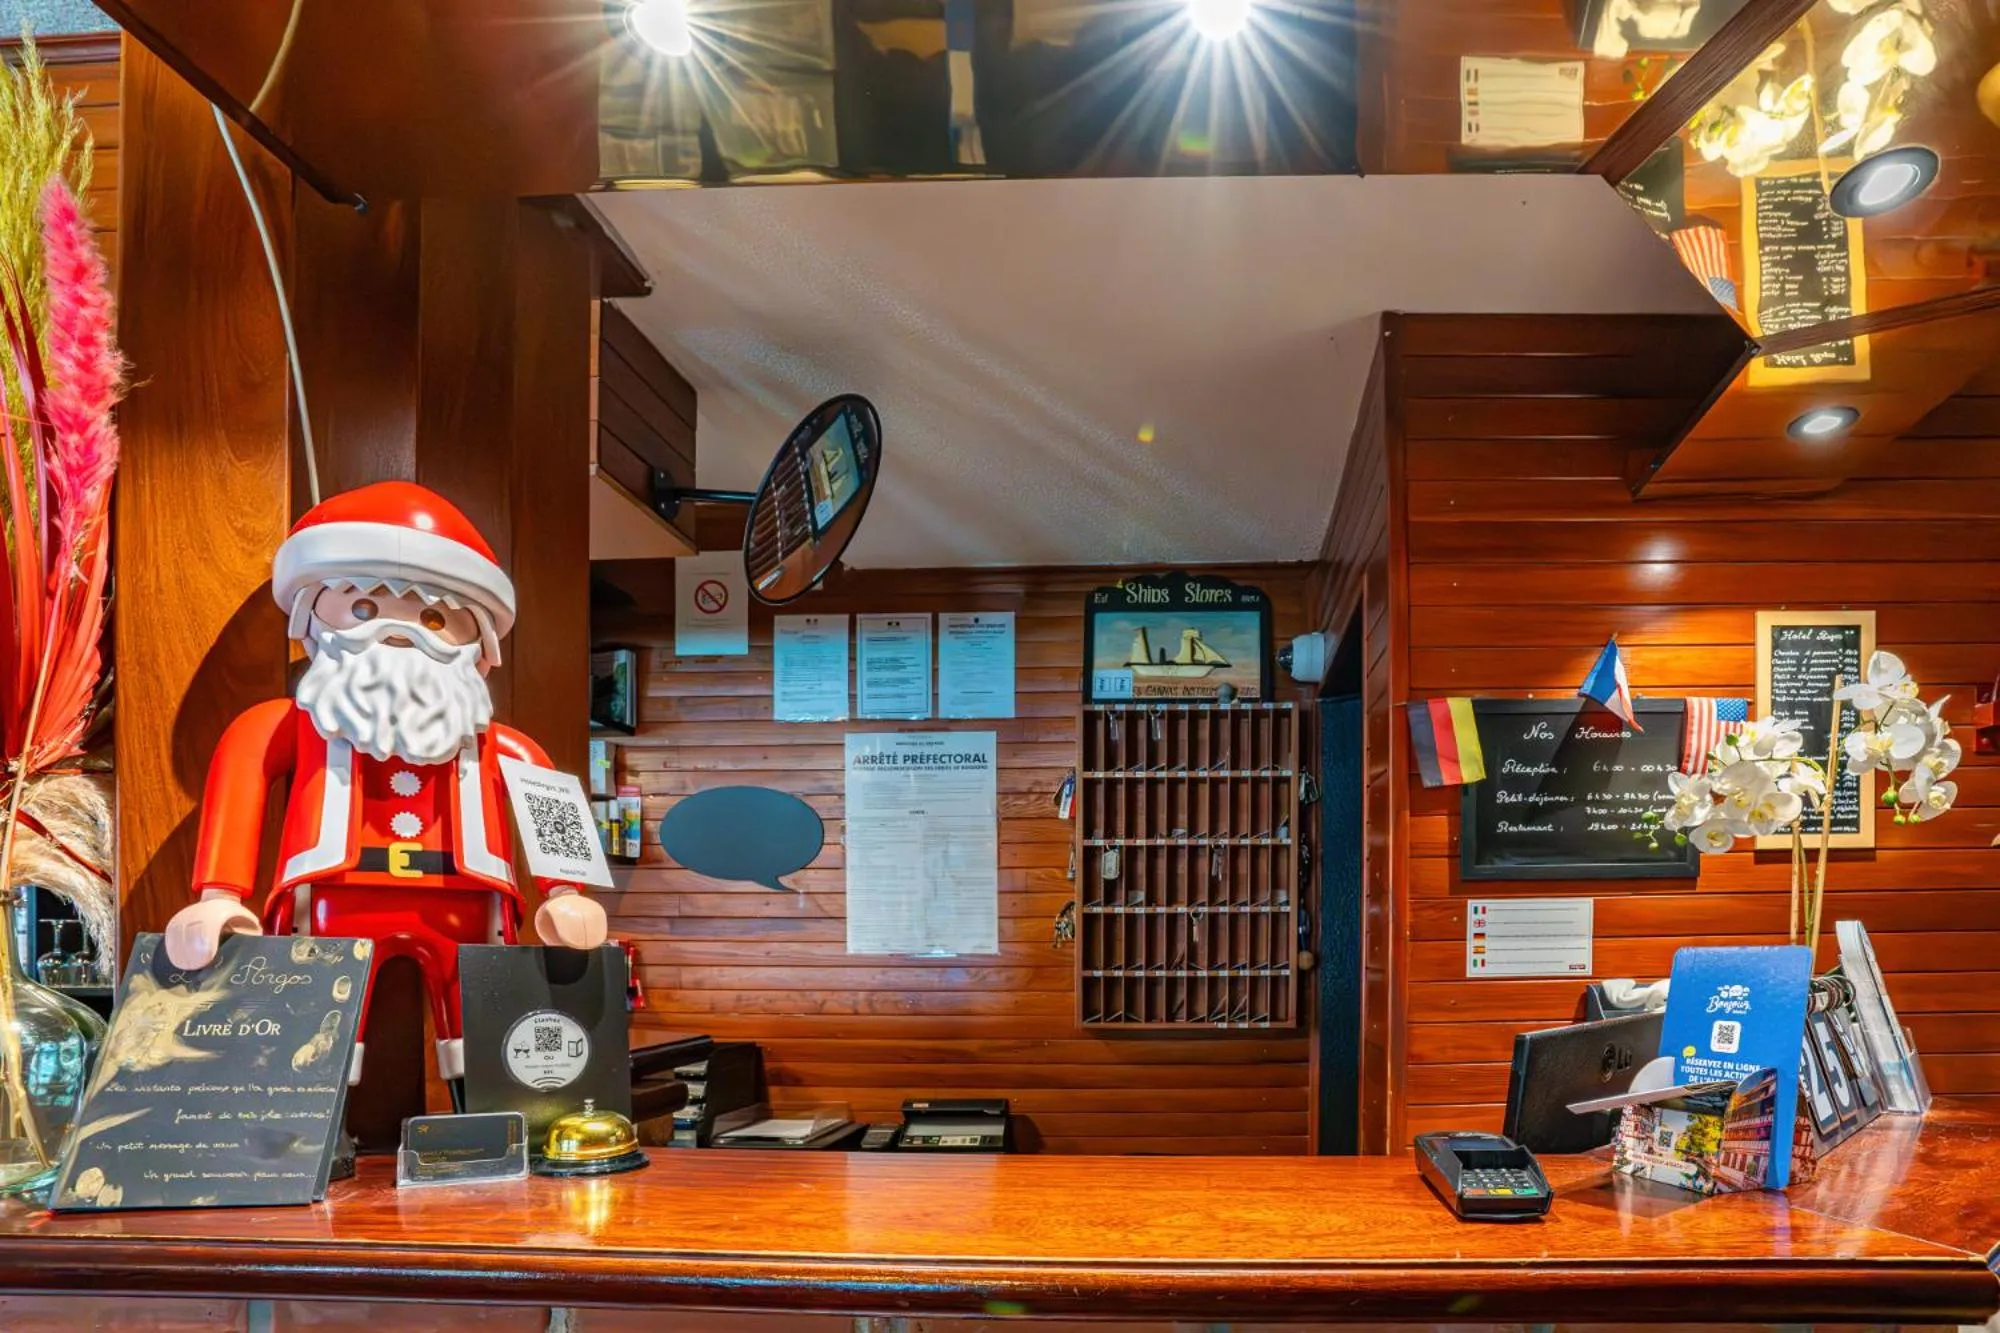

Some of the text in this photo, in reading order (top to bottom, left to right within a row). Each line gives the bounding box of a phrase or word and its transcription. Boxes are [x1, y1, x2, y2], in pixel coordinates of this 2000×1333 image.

[1126, 583, 1170, 604] Ships
[1184, 582, 1233, 604] Stores
[1523, 721, 1632, 740] Nos Horaires
[852, 752, 989, 765] ARRÊTÉ PRÉFECTORAL
[1686, 1057, 1722, 1069] RÉSERVEZ
[1723, 1060, 1735, 1070] EN
[1680, 1066, 1708, 1076] TOUTES
[1709, 1067, 1723, 1077] LES
